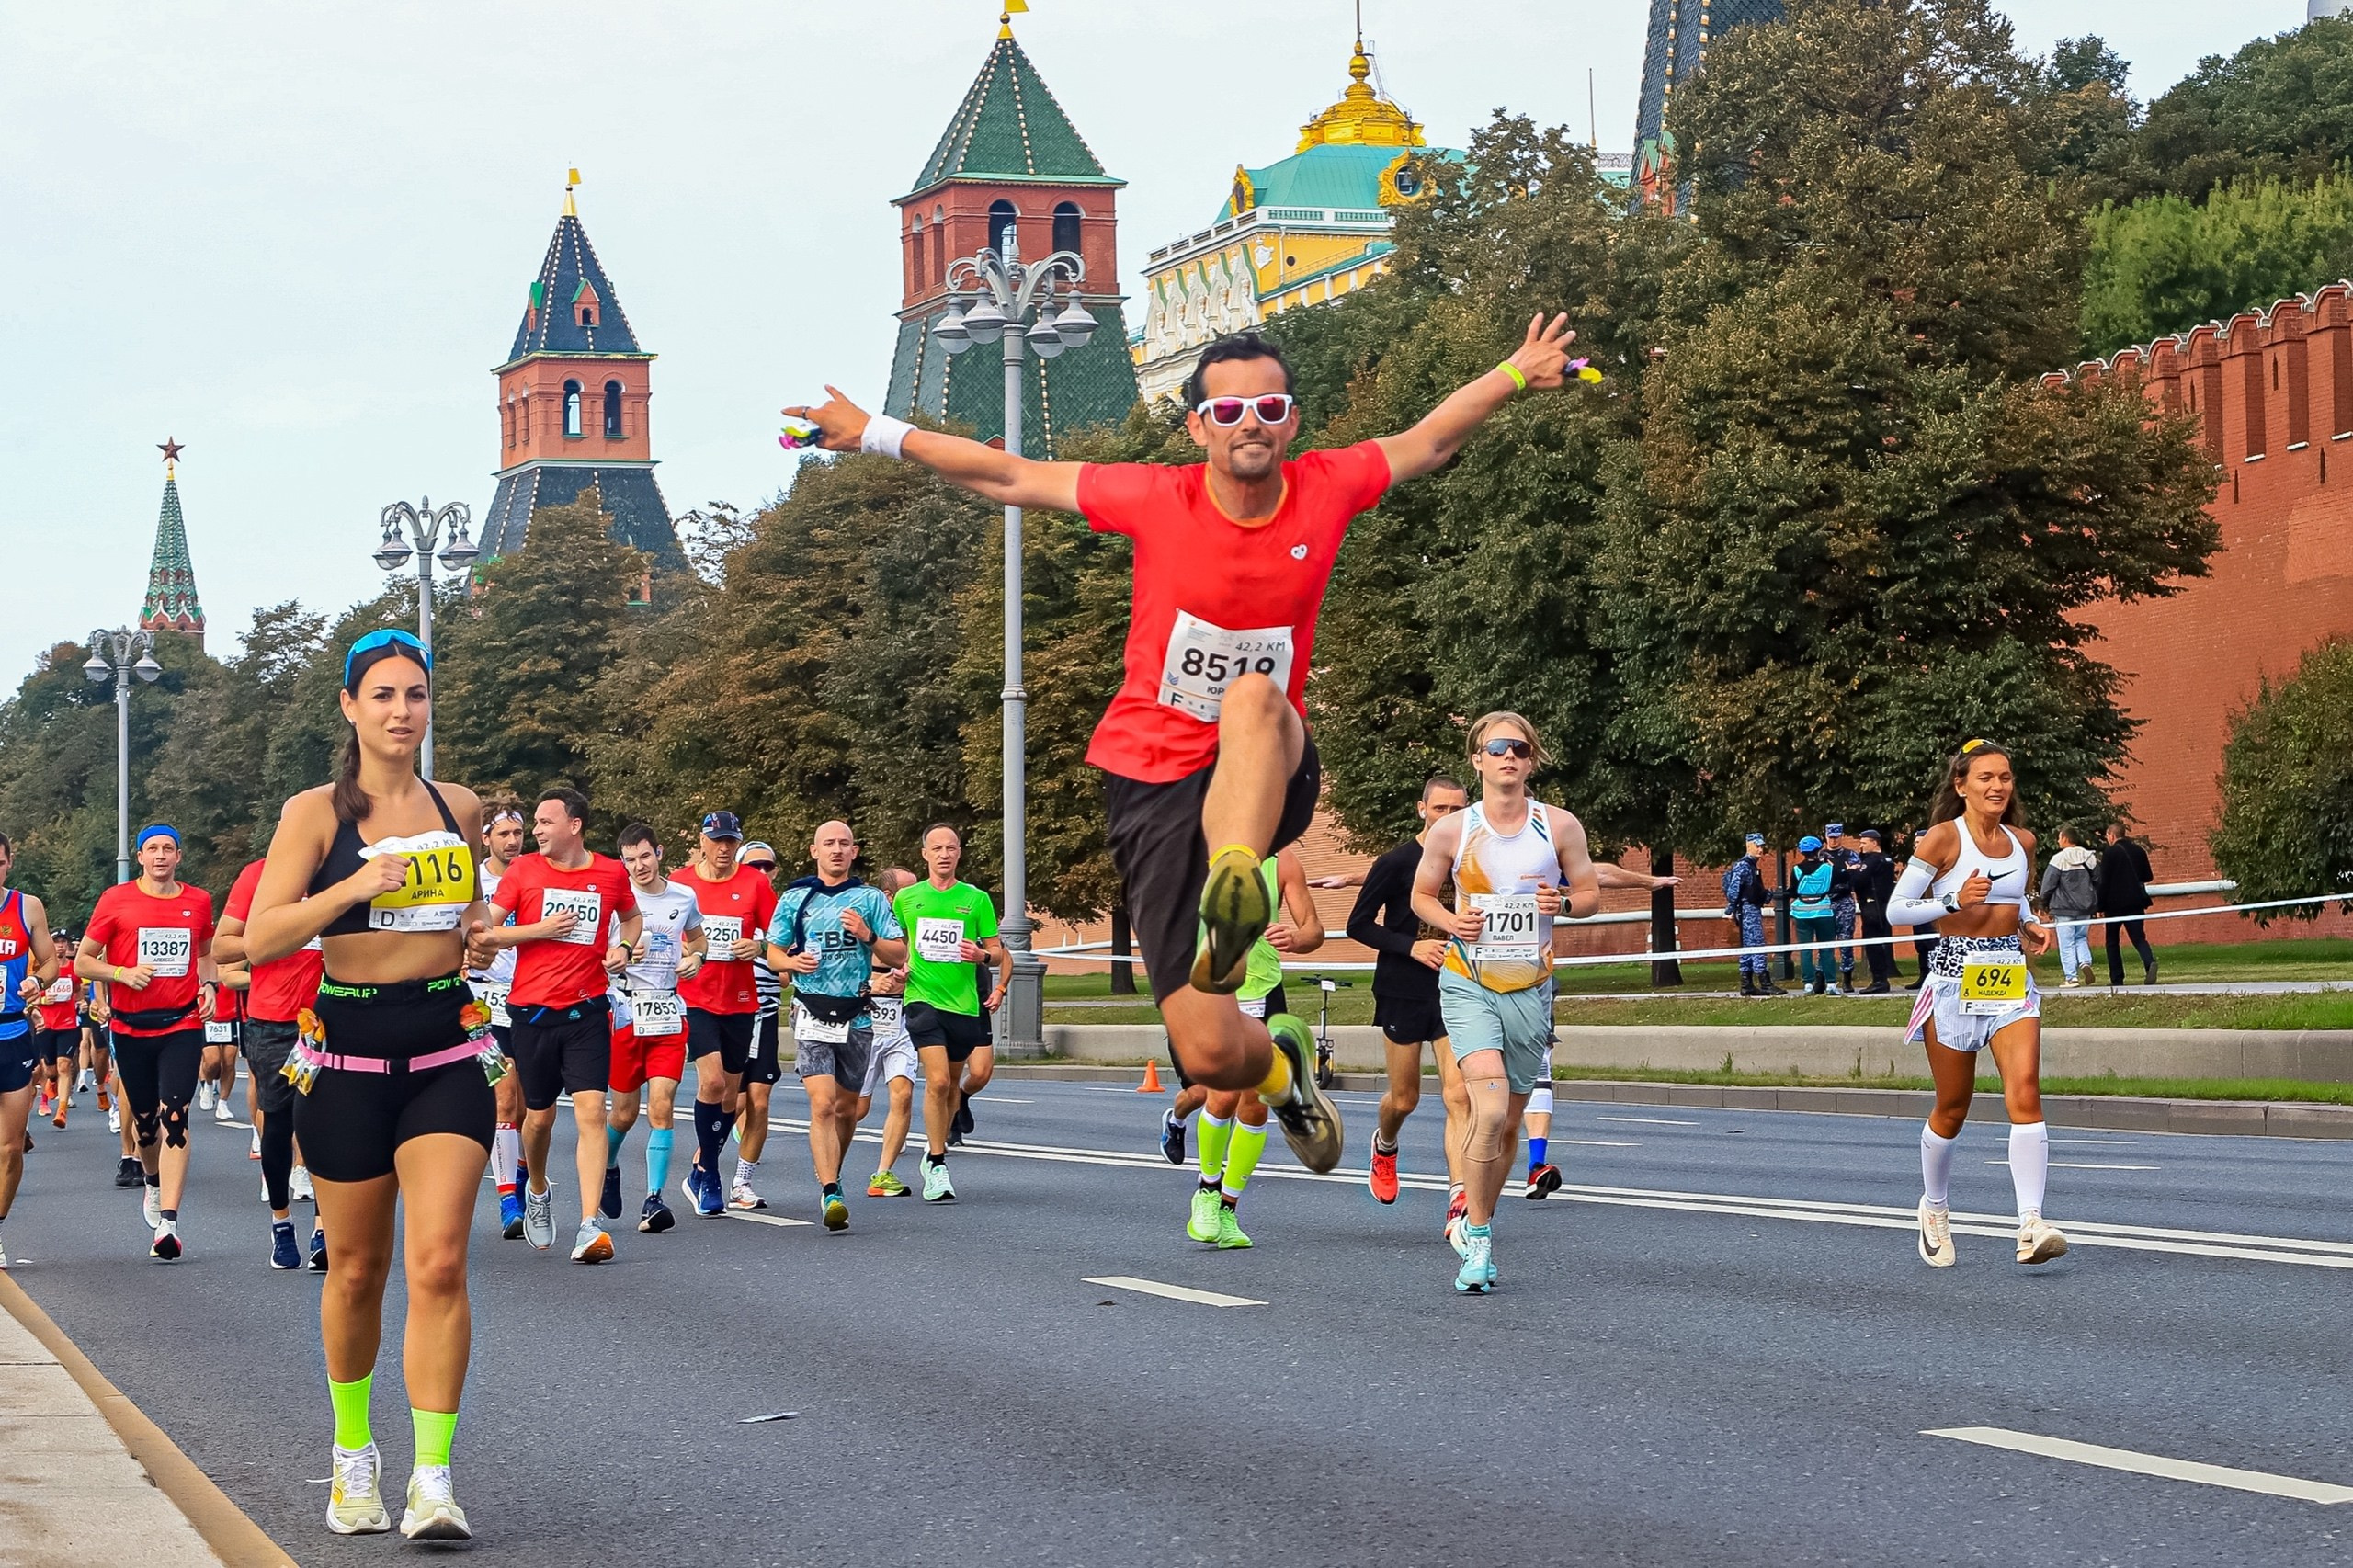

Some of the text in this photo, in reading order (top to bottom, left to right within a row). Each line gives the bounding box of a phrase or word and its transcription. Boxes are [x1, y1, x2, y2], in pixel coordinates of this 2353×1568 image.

[1235, 641, 1263, 652] 42,2
[1206, 685, 1225, 696] ЮР
[1170, 691, 1184, 707] F
[400, 851, 463, 887] 116
[411, 888, 445, 901] АРИНА
[381, 910, 395, 927] D
[1484, 912, 1534, 933] 1701
[704, 926, 740, 943] 2250
[922, 929, 958, 945] 4450
[141, 940, 189, 956] 13387
[1475, 947, 1483, 958] F
[1975, 968, 2012, 987] 694
[481, 990, 507, 1007] 153
[635, 1001, 677, 1017] 17853
[872, 1006, 897, 1021] 593
[1965, 1001, 1973, 1013] F
[209, 1025, 227, 1033] 7631
[638, 1026, 645, 1035] D
